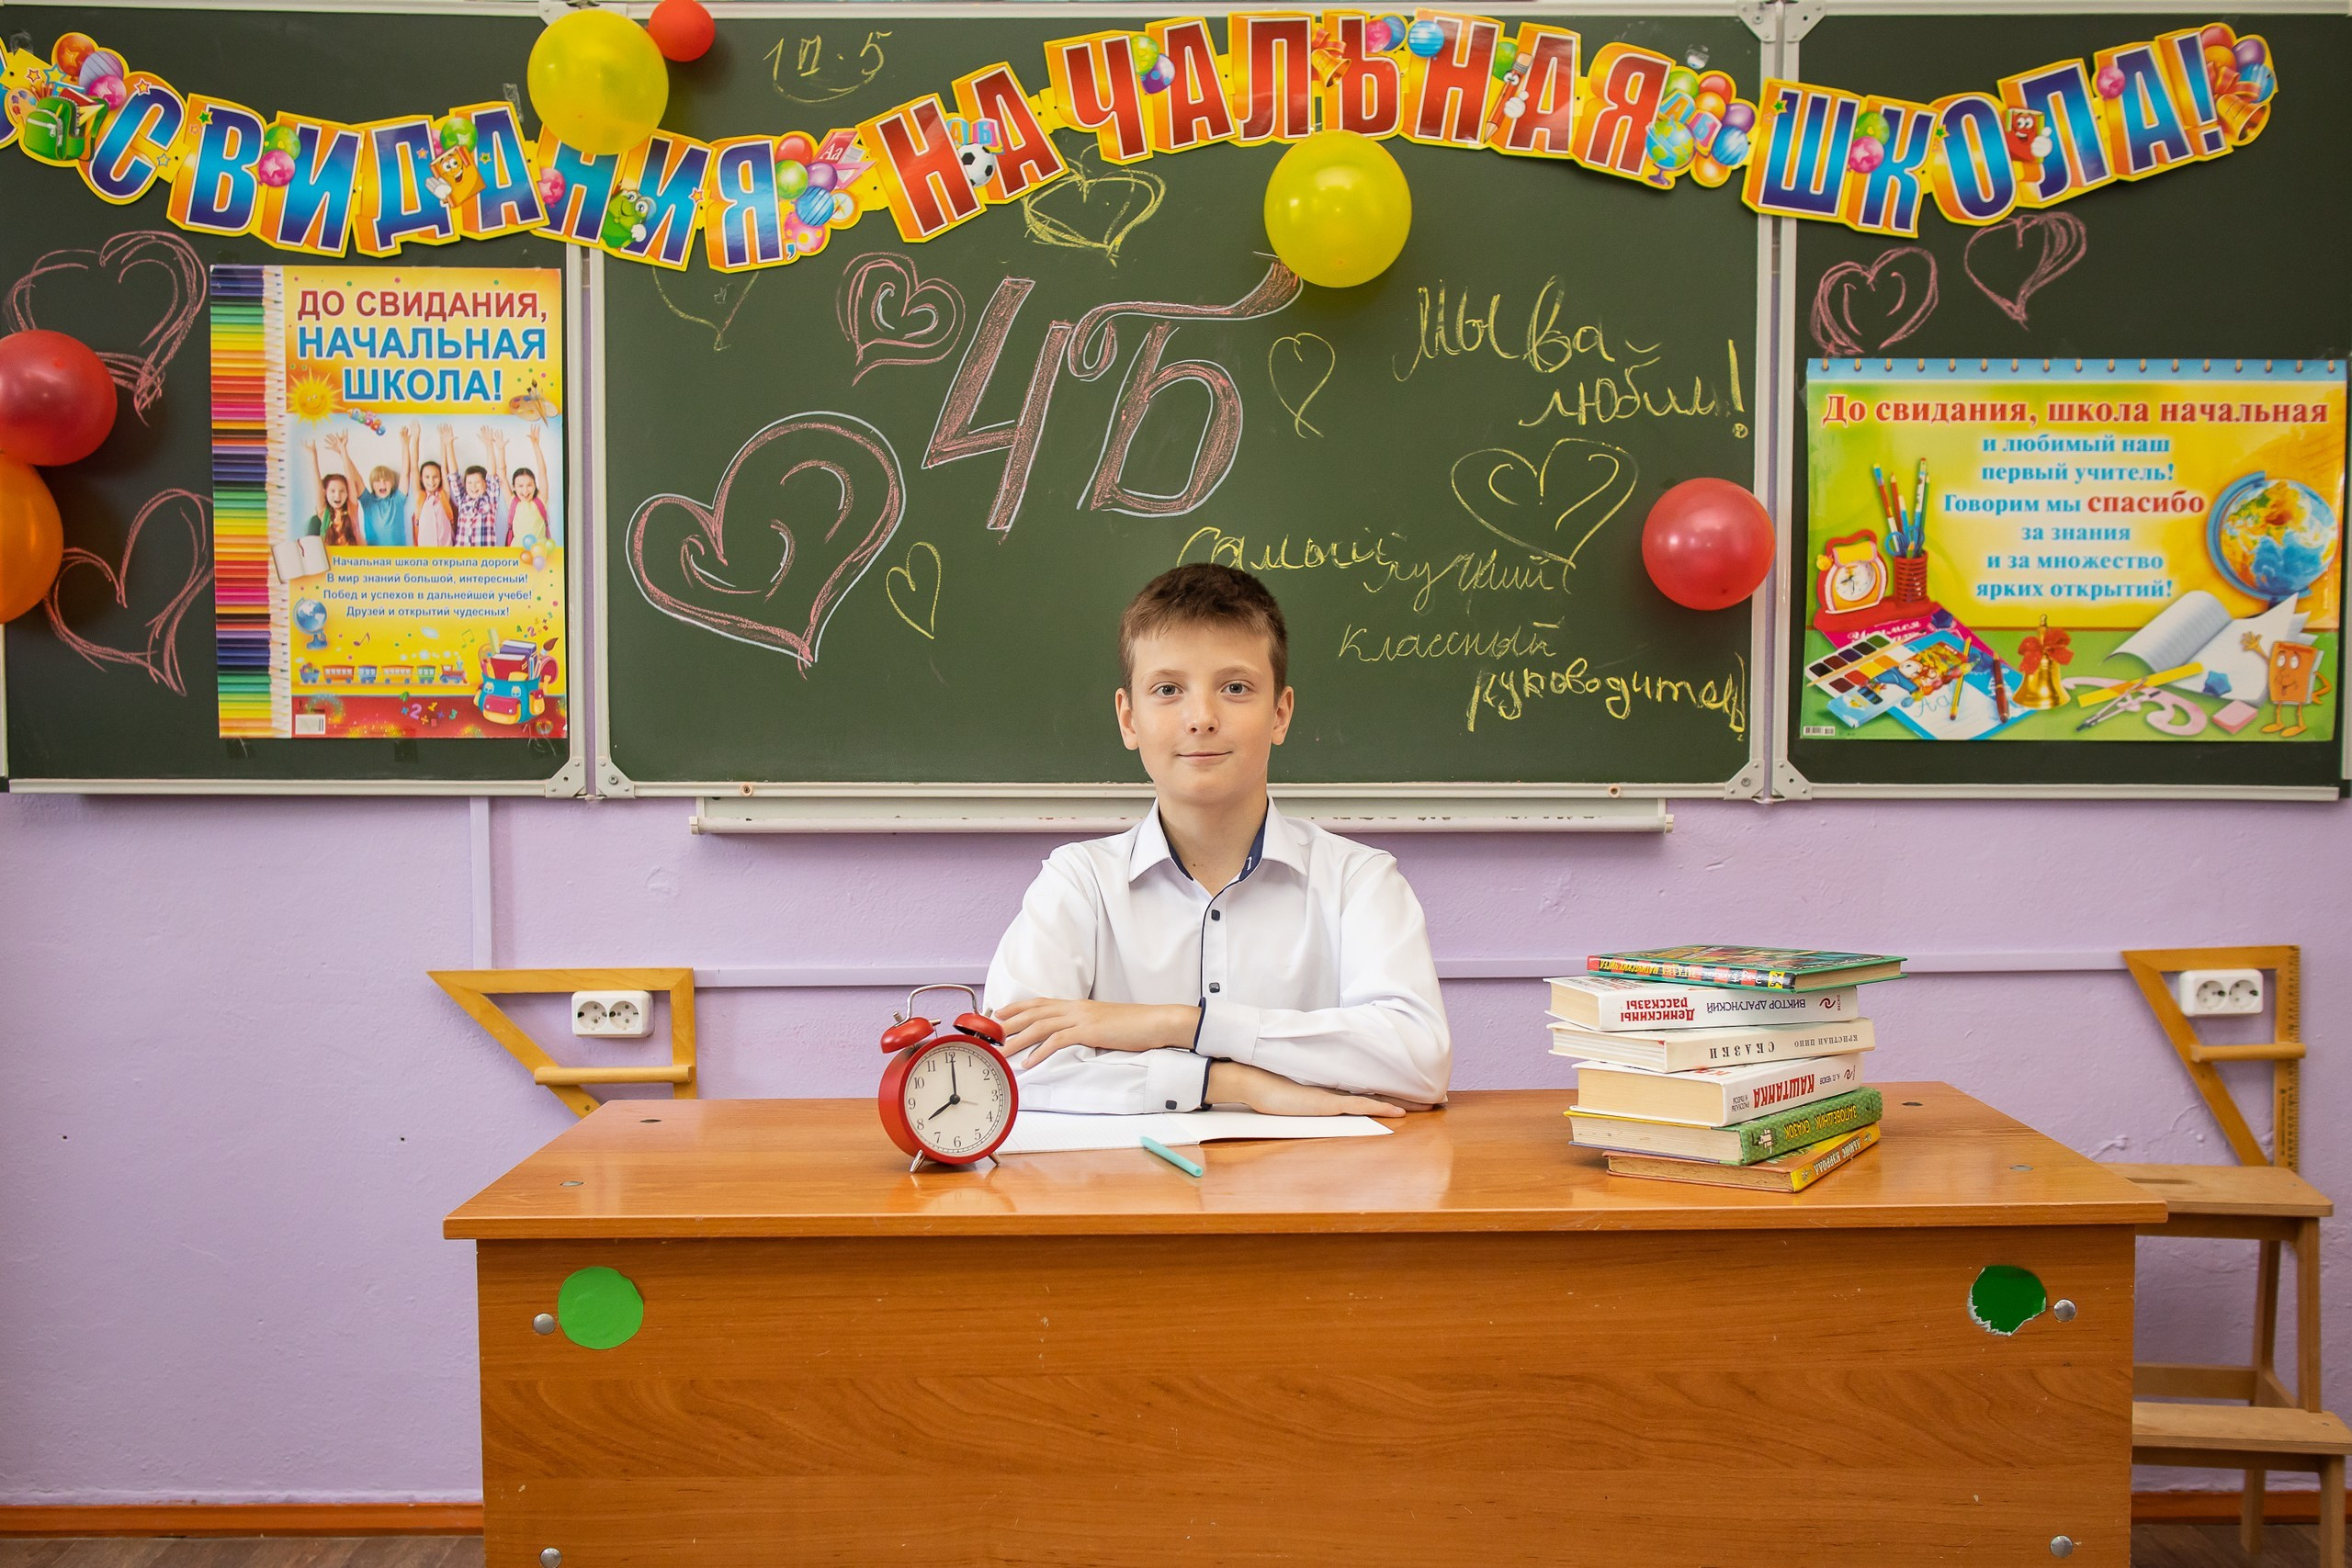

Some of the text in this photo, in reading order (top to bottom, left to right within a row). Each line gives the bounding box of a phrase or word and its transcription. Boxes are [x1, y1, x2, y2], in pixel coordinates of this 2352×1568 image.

[876, 15, 1672, 238] НАЧАЛЬНАЯ
[1759, 31, 2227, 231] ШКОЛА!
[298, 290, 548, 323] ДО СВИДАНИЯ,
[1393, 278, 1520, 382] Мы
[298, 327, 547, 360] НАЧАЛЬНАЯ
[344, 368, 502, 400] ШКОЛА!
[922, 251, 1305, 544] 4Б
[1822, 395, 2329, 429] До свидания, школа начальная
[1983, 434, 2170, 453] и любимый наш
[1982, 463, 2174, 484] первый учитель!
[1943, 491, 2204, 515] Говорим мы спасибо
[2021, 526, 2131, 541] за знания
[333, 557, 519, 569] Начальная школа открыла дороги
[1987, 555, 2164, 570] и за множество
[327, 573, 528, 585] В мир знаний большой, интересный!
[1976, 579, 2173, 600] ярких открытий!
[323, 590, 357, 601] Побед
[371, 592, 413, 603] успехов
[427, 590, 494, 602] дальнейшей
[498, 591, 532, 602] учебе!
[346, 606, 385, 618] Друзей
[399, 606, 450, 618] открытий
[454, 607, 510, 618] чудесных!
[1625, 997, 1689, 1010] рассказы
[1706, 998, 1806, 1013] ВИКТОР ДРАГУНСКИЙ
[1620, 1008, 1695, 1022] Денискины
[1793, 1034, 1858, 1047] КРИСТИАН ПИНО
[1709, 1043, 1775, 1059] СКАЗКИ
[944, 1052, 956, 1064] 12
[967, 1055, 972, 1067] 1
[927, 1060, 936, 1072] 11
[983, 1069, 990, 1080] 2
[913, 1077, 925, 1089] 10
[991, 1089, 999, 1102] 3
[1753, 1073, 1815, 1109] КАШТАНКА
[908, 1098, 916, 1110] 9
[986, 1111, 993, 1122] 4
[1783, 1103, 1858, 1141] ЗАПОВЕДНИК СКАЗОК
[917, 1119, 924, 1131] 8
[933, 1132, 941, 1144] 7
[974, 1128, 982, 1141] 5
[954, 1136, 961, 1148] 6
